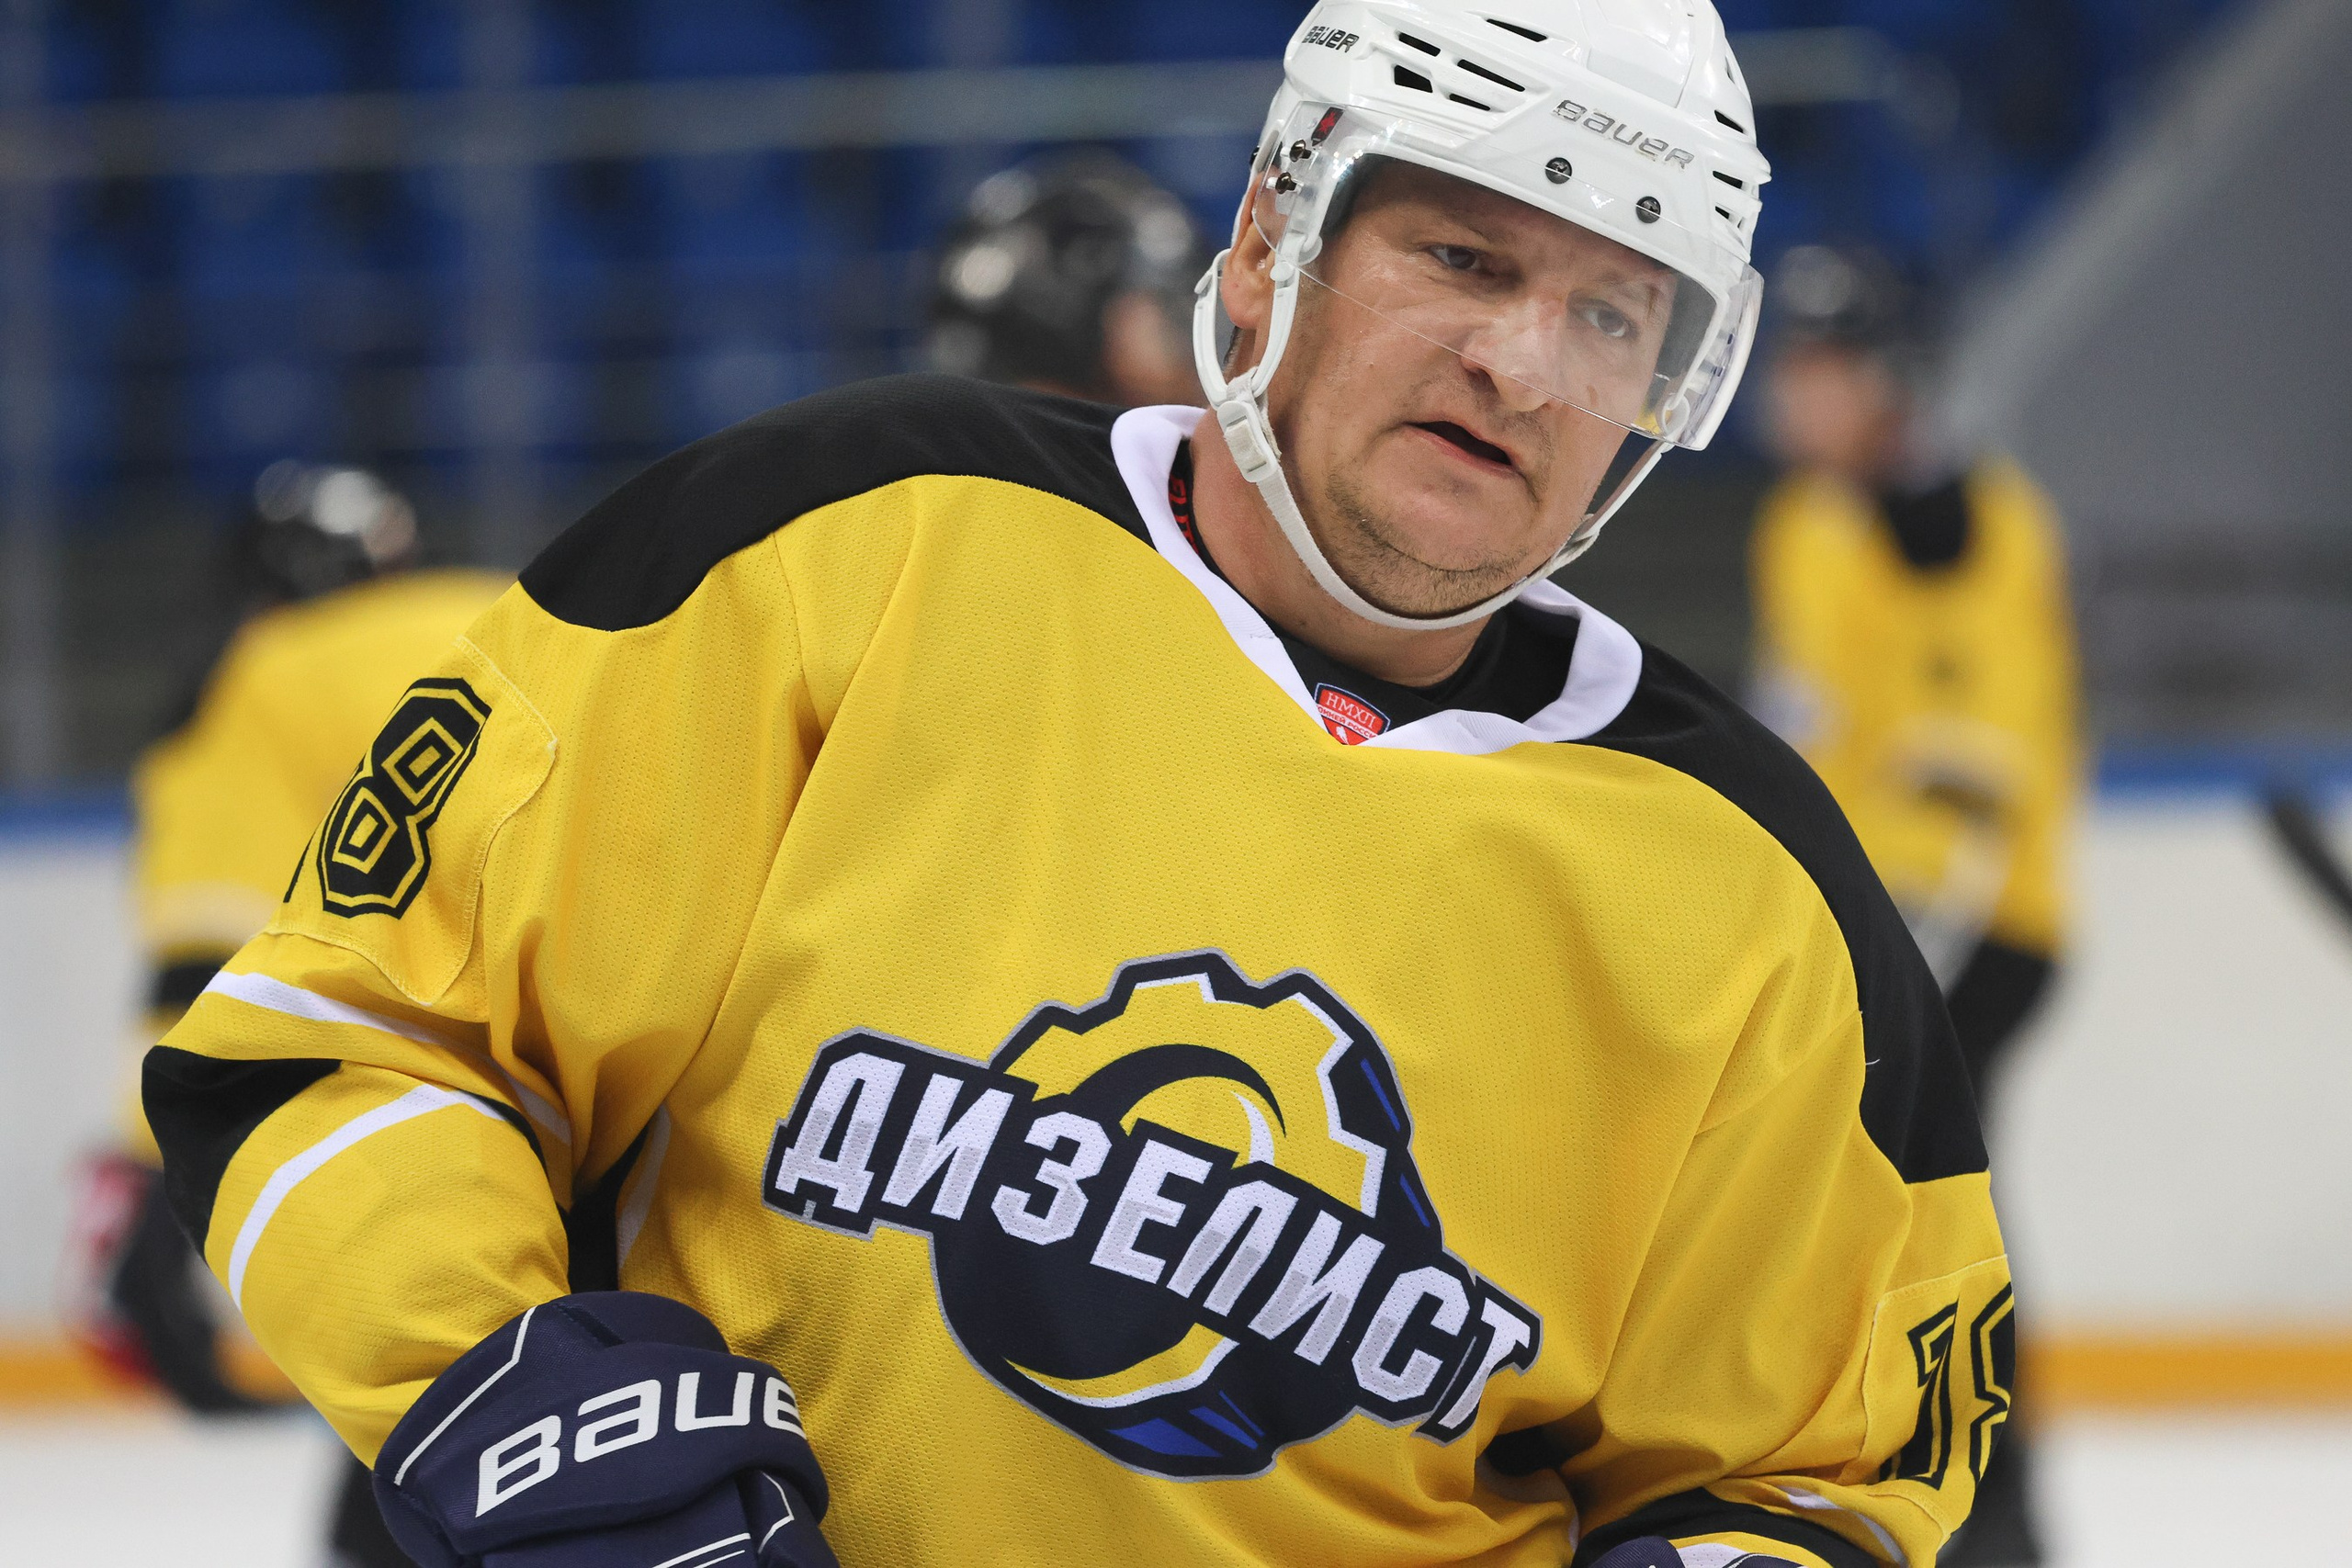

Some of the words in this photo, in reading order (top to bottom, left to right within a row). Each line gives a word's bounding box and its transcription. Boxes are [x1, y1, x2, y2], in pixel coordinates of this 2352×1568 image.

[1317, 705, 1346, 724] ОККЕЙ
[1326, 692, 1376, 729] НМХЛ
[283, 677, 492, 920] 8
[775, 1052, 1532, 1429] ДИЗЕЛИСТ
[475, 1371, 808, 1518] BAUE
